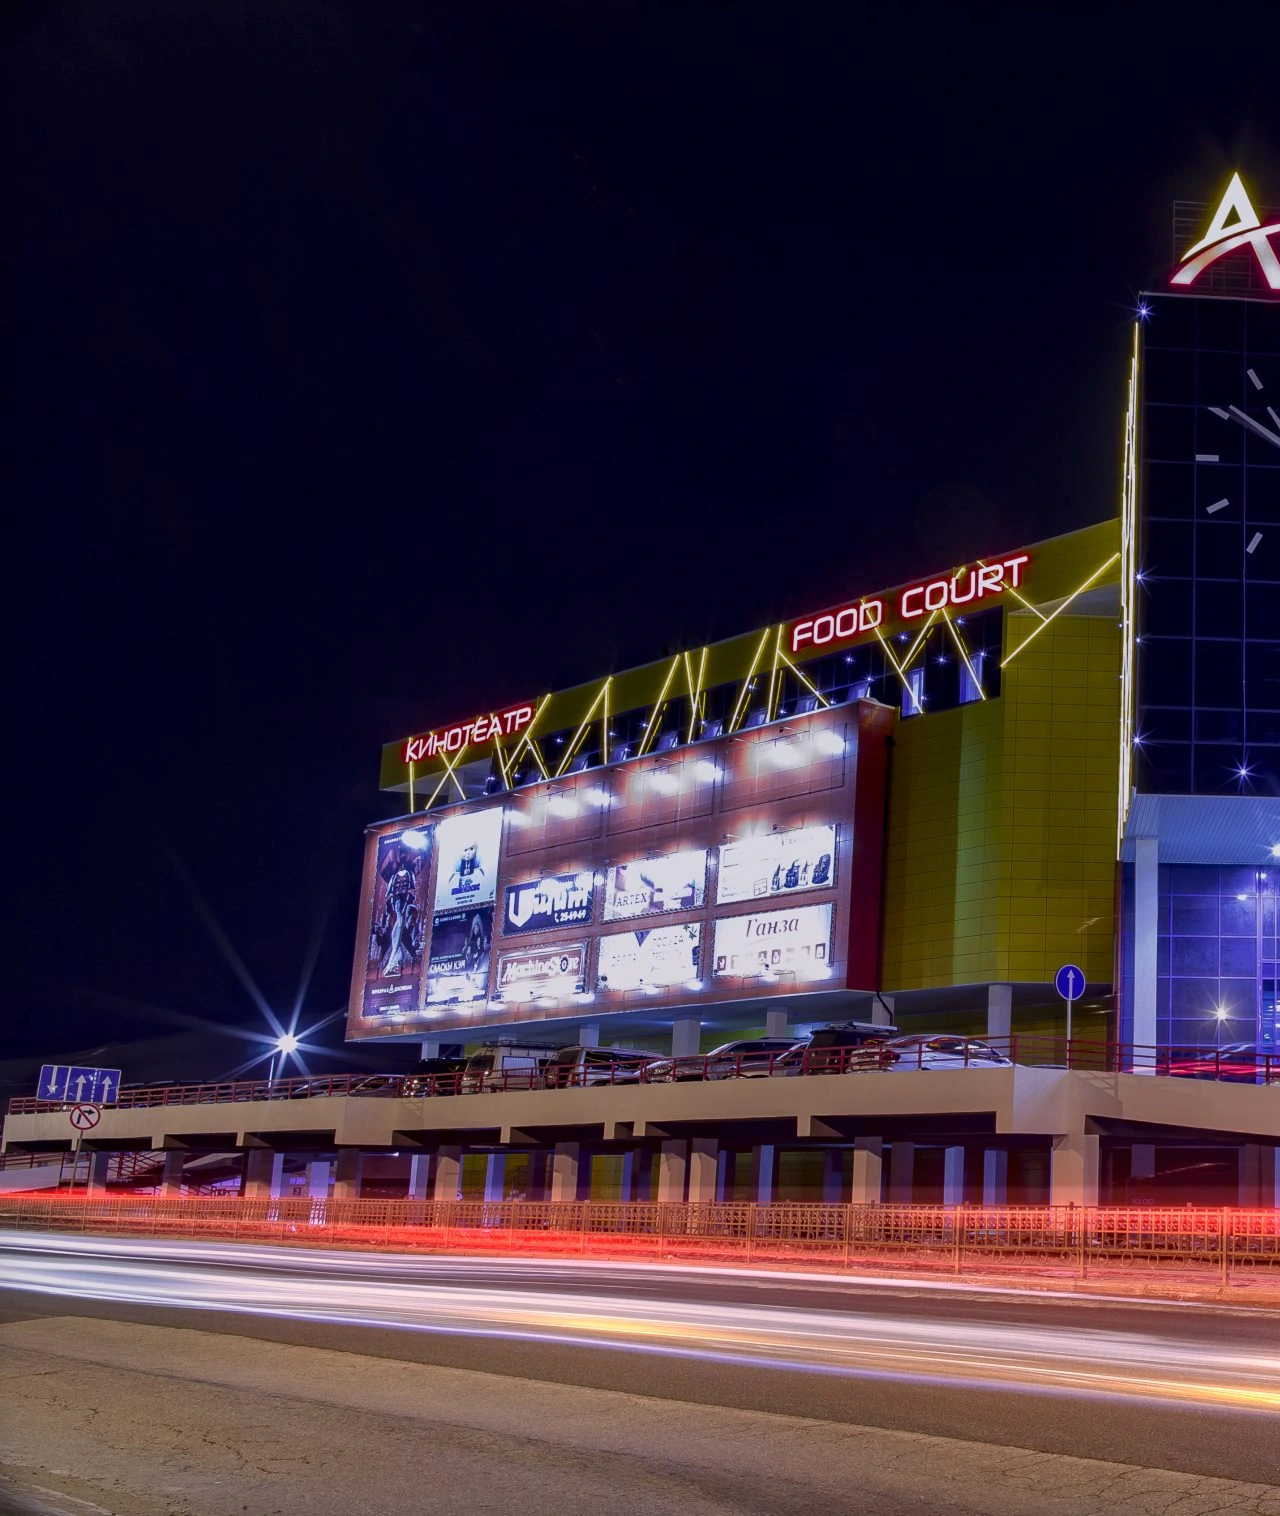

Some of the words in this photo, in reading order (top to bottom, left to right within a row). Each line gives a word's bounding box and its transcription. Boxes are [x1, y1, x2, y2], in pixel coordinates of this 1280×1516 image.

[793, 601, 882, 651] FOOD
[902, 556, 1028, 618] COURT
[405, 707, 532, 763] КИНОТЕАТР
[745, 917, 800, 938] Ганза
